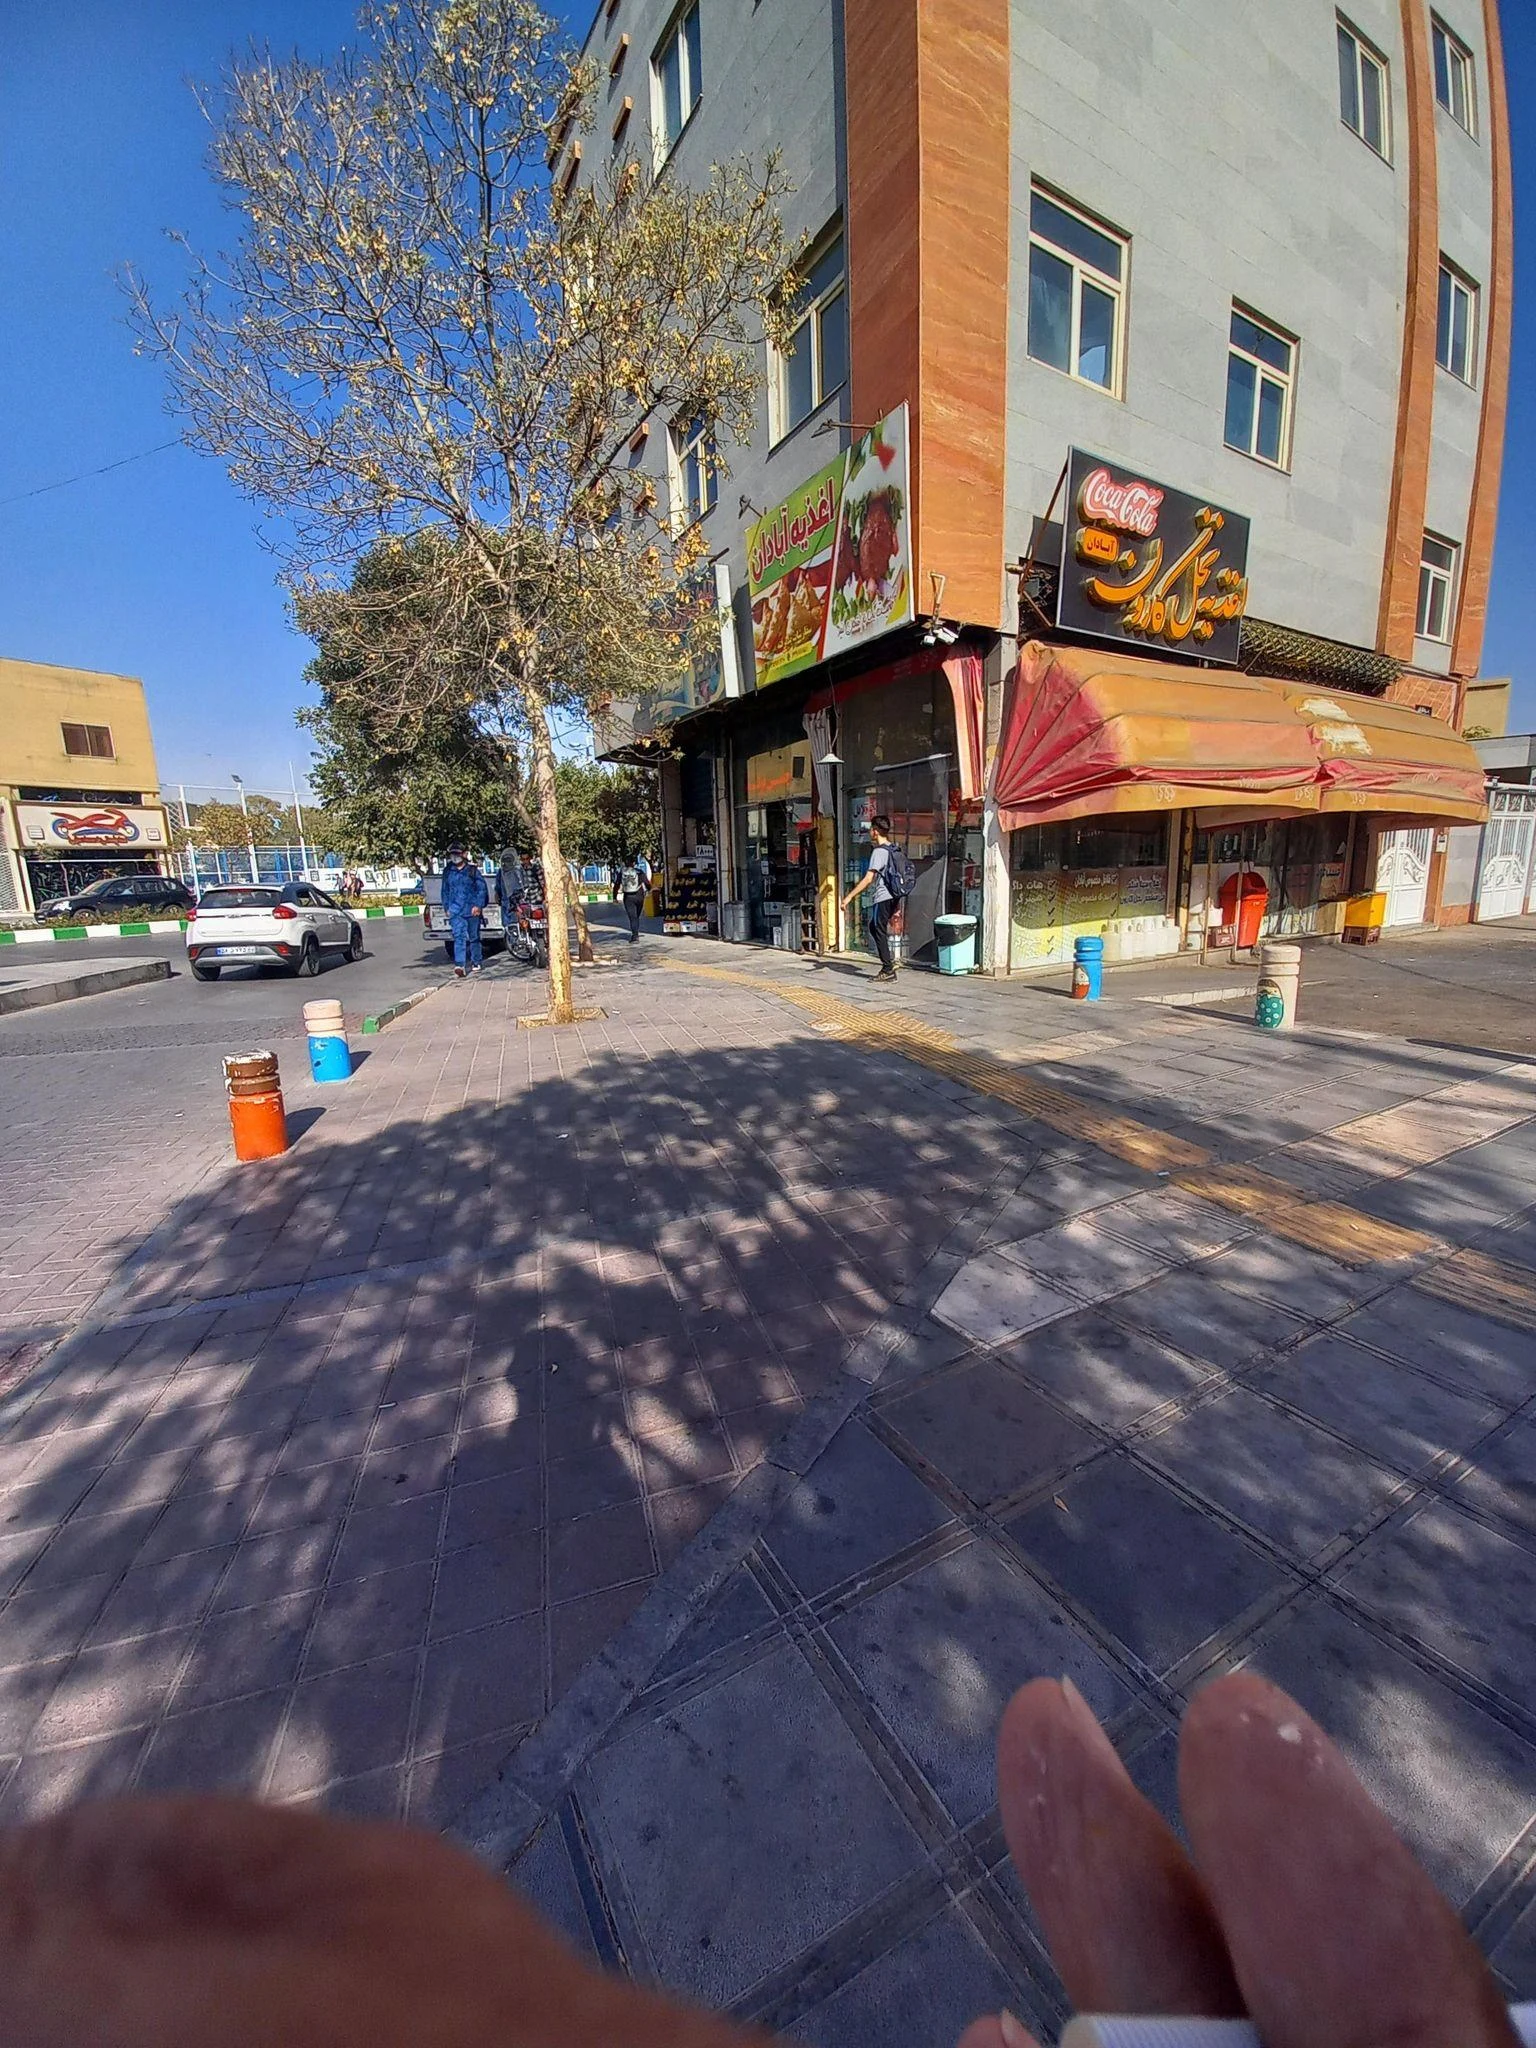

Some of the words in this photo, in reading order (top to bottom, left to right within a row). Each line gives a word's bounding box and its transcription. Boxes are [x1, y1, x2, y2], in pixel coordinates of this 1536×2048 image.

[749, 504, 789, 583] آبادان
[790, 476, 835, 552] اغذیه
[1086, 536, 1115, 557] آبادان
